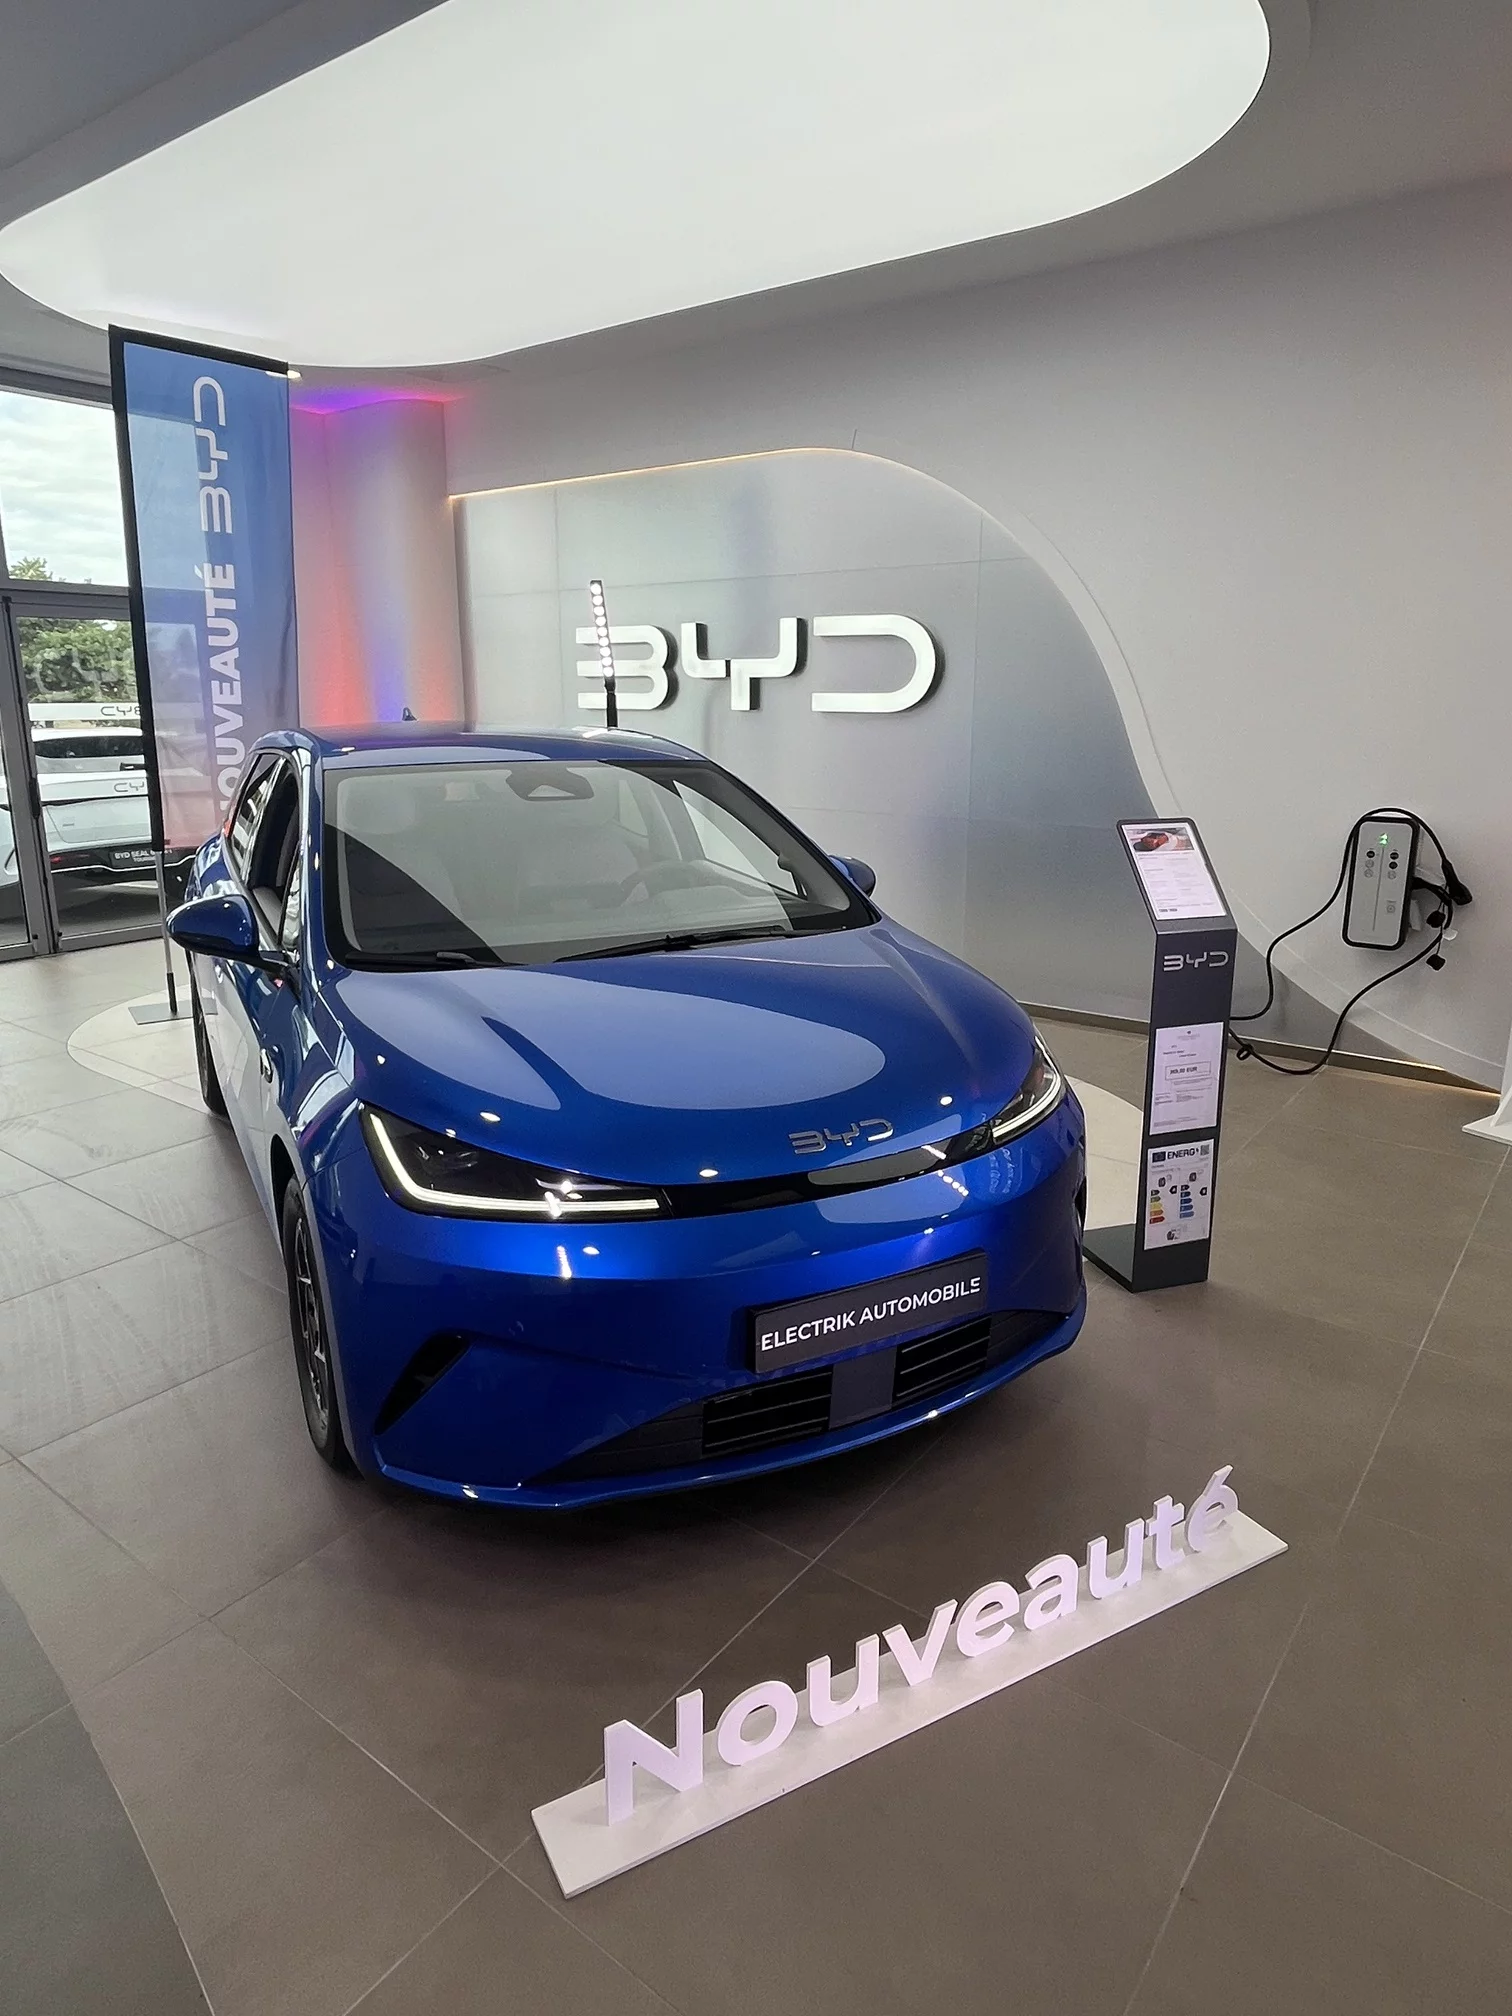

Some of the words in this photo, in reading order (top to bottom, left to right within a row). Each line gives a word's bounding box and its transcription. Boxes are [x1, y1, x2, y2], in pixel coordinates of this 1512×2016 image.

[193, 376, 233, 534] BYD
[576, 614, 937, 714] BYD
[114, 851, 131, 860] BYD
[131, 850, 149, 858] SEAL
[1163, 951, 1229, 972] BYD
[788, 1118, 894, 1154] BYD
[760, 1310, 856, 1351] ELECTRIK
[859, 1276, 982, 1325] AUTOMOBILE
[604, 1464, 1240, 1827] Nouveauté
